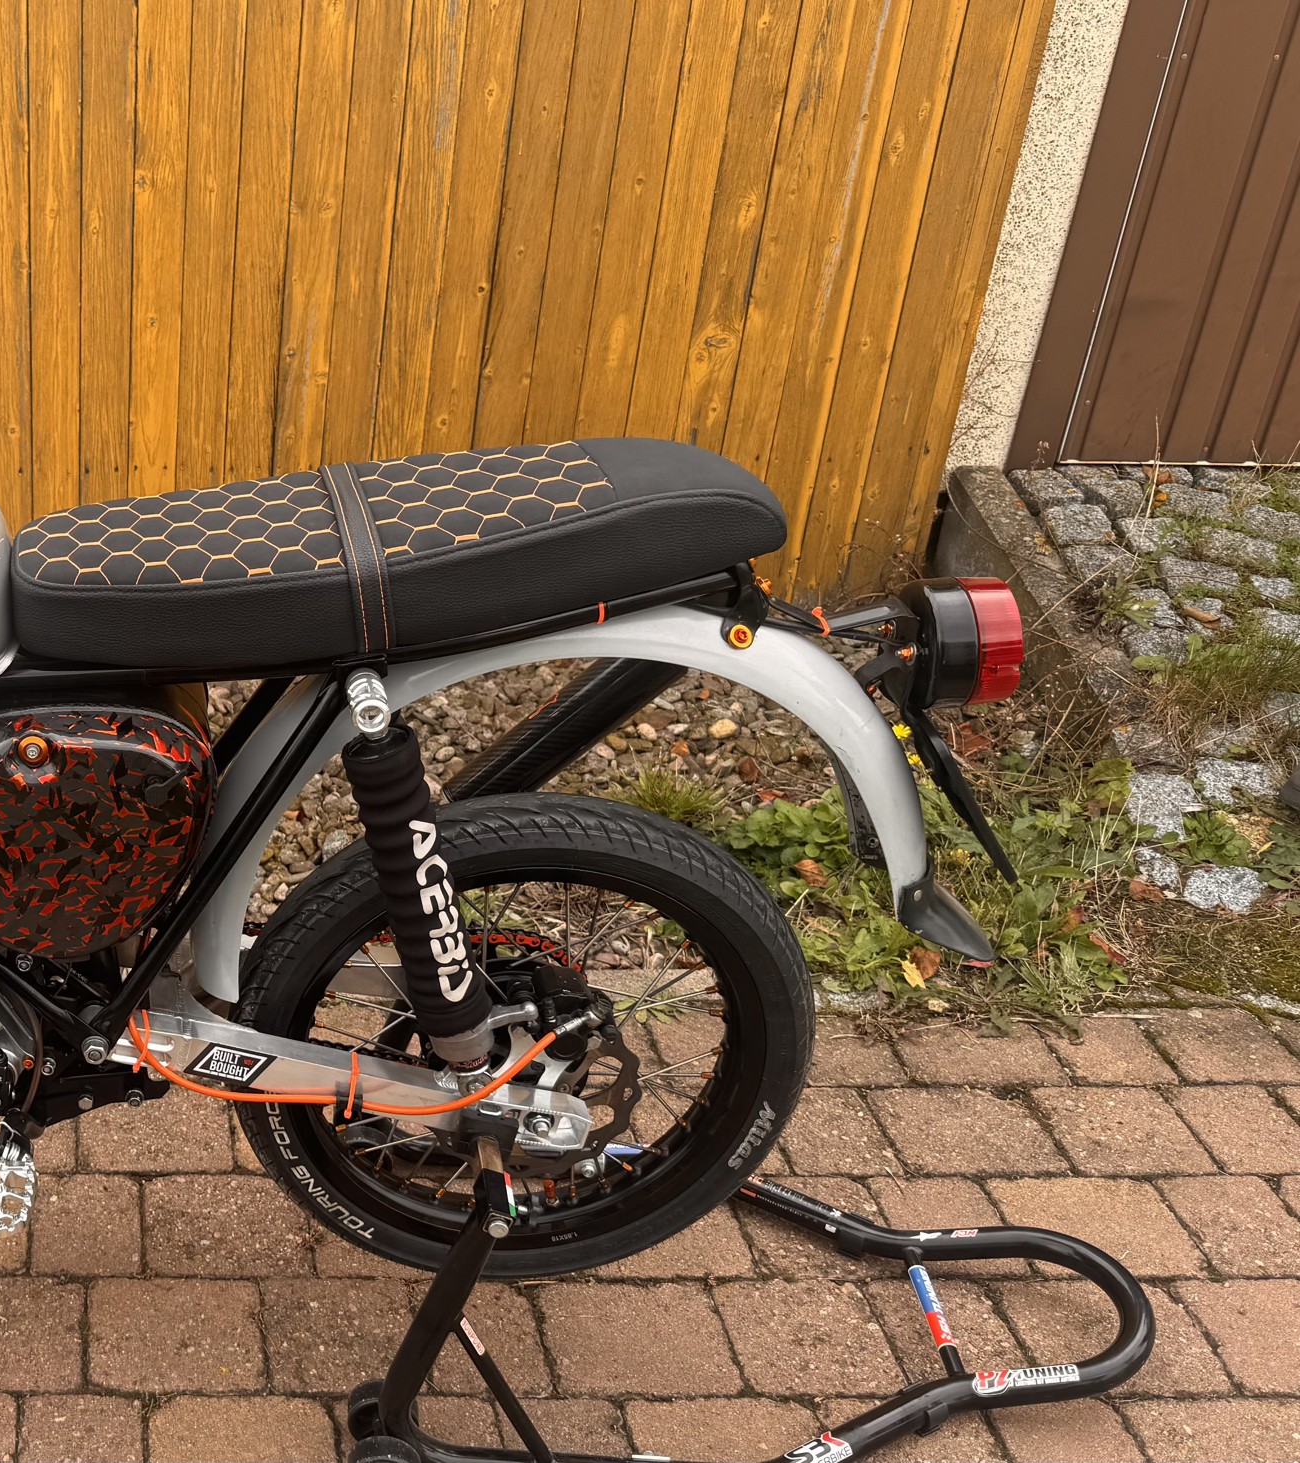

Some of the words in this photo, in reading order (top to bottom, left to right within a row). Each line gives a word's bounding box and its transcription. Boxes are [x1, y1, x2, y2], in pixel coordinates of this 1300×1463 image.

[209, 1060, 250, 1078] BOUGHT
[212, 1050, 241, 1065] BUILT
[727, 1100, 776, 1170] Mitas
[291, 1165, 375, 1239] TOURING
